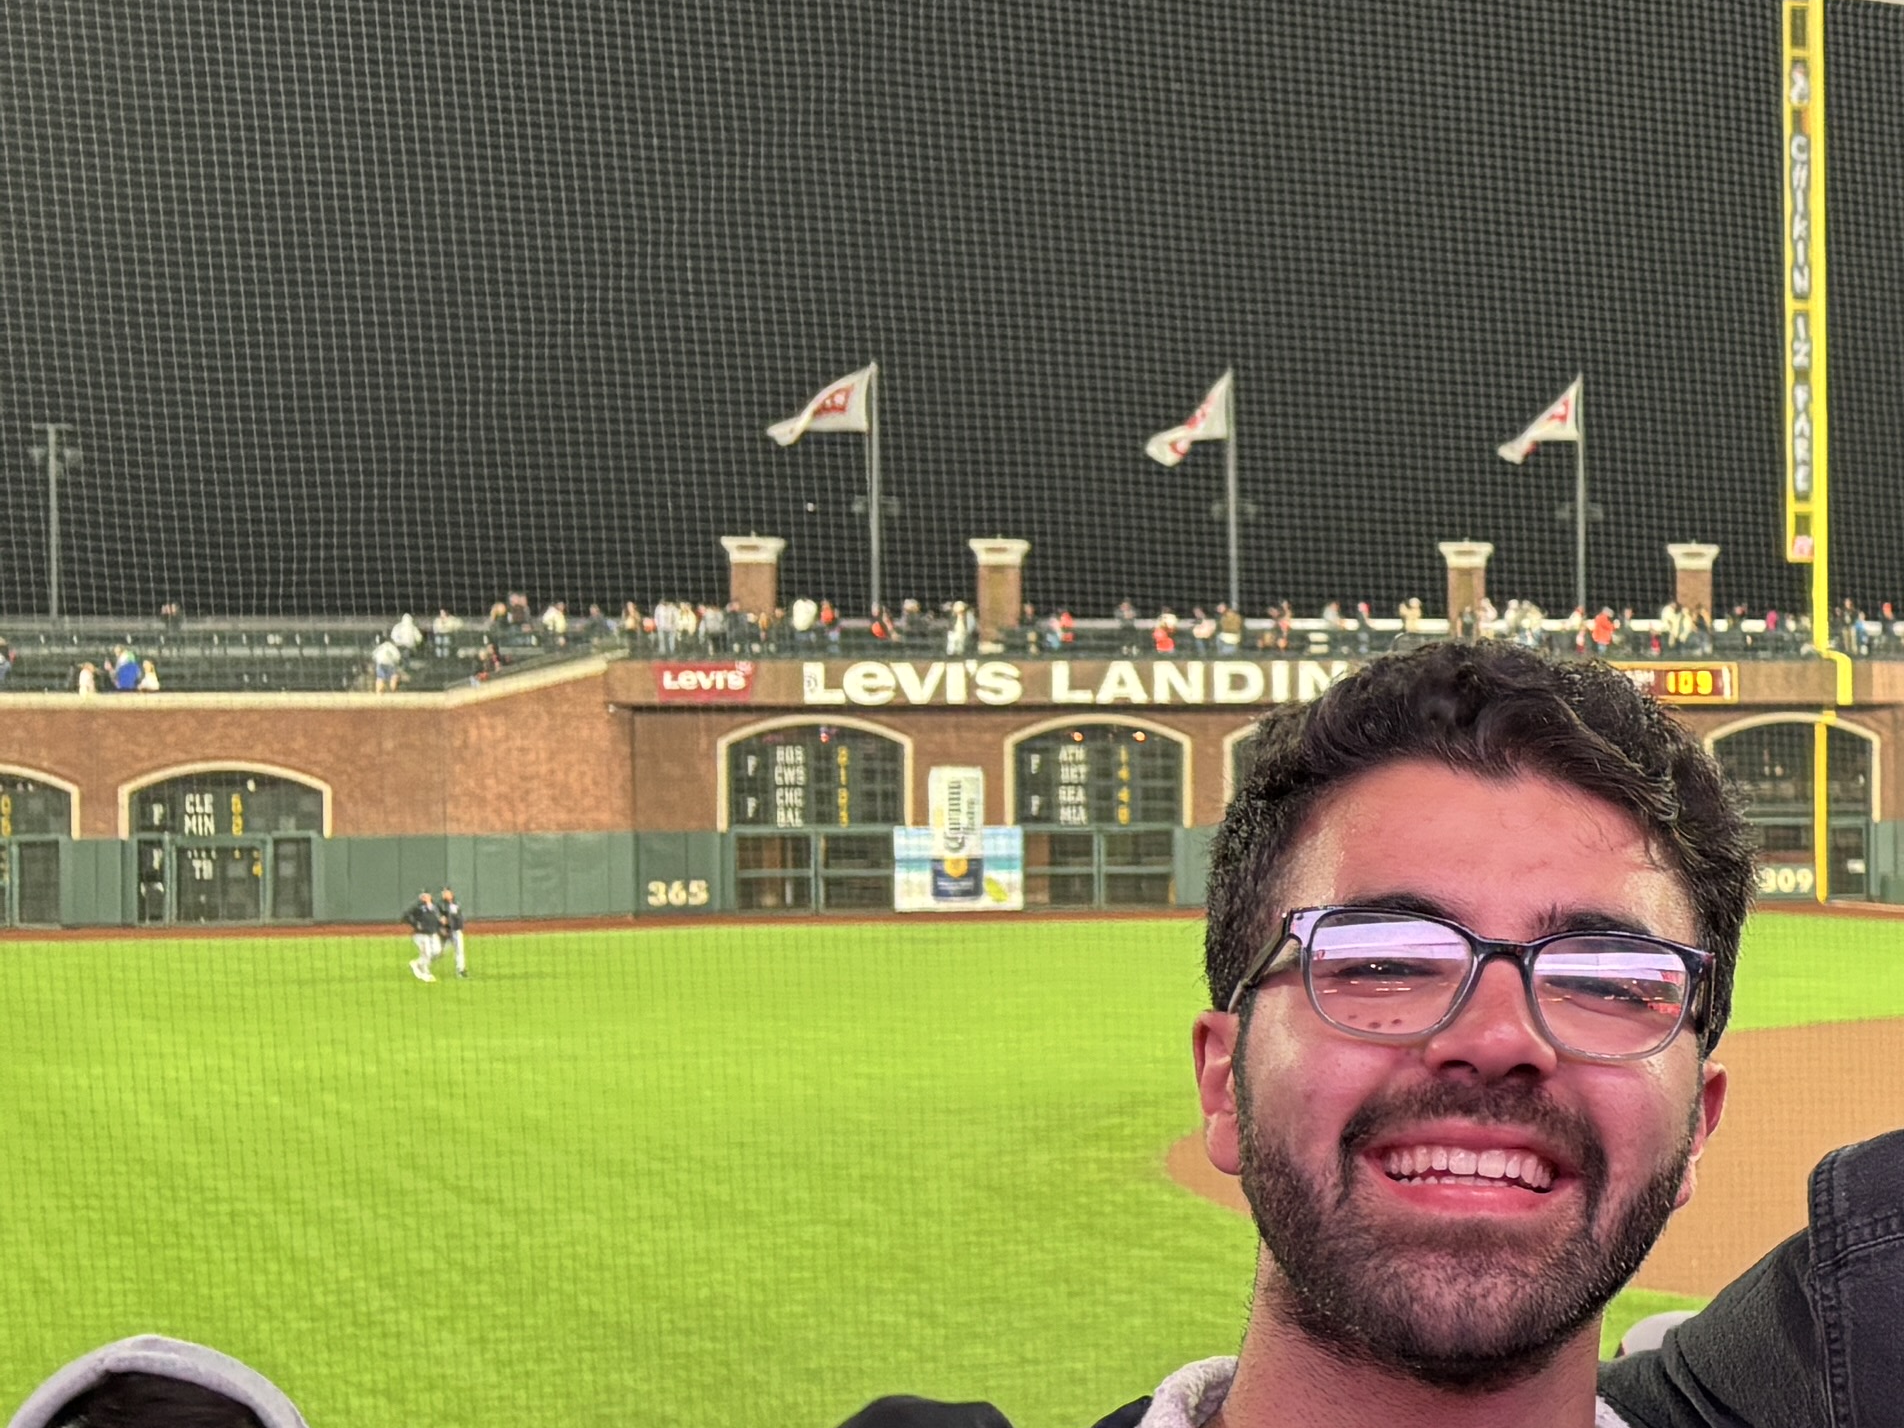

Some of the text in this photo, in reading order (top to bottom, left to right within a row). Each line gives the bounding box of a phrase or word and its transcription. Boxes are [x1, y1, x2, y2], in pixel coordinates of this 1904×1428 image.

[1051, 659, 1350, 705] LANDIN
[1666, 670, 1713, 695] 109
[184, 793, 214, 814] CLE
[183, 814, 216, 836] MIN
[647, 880, 710, 907] 365
